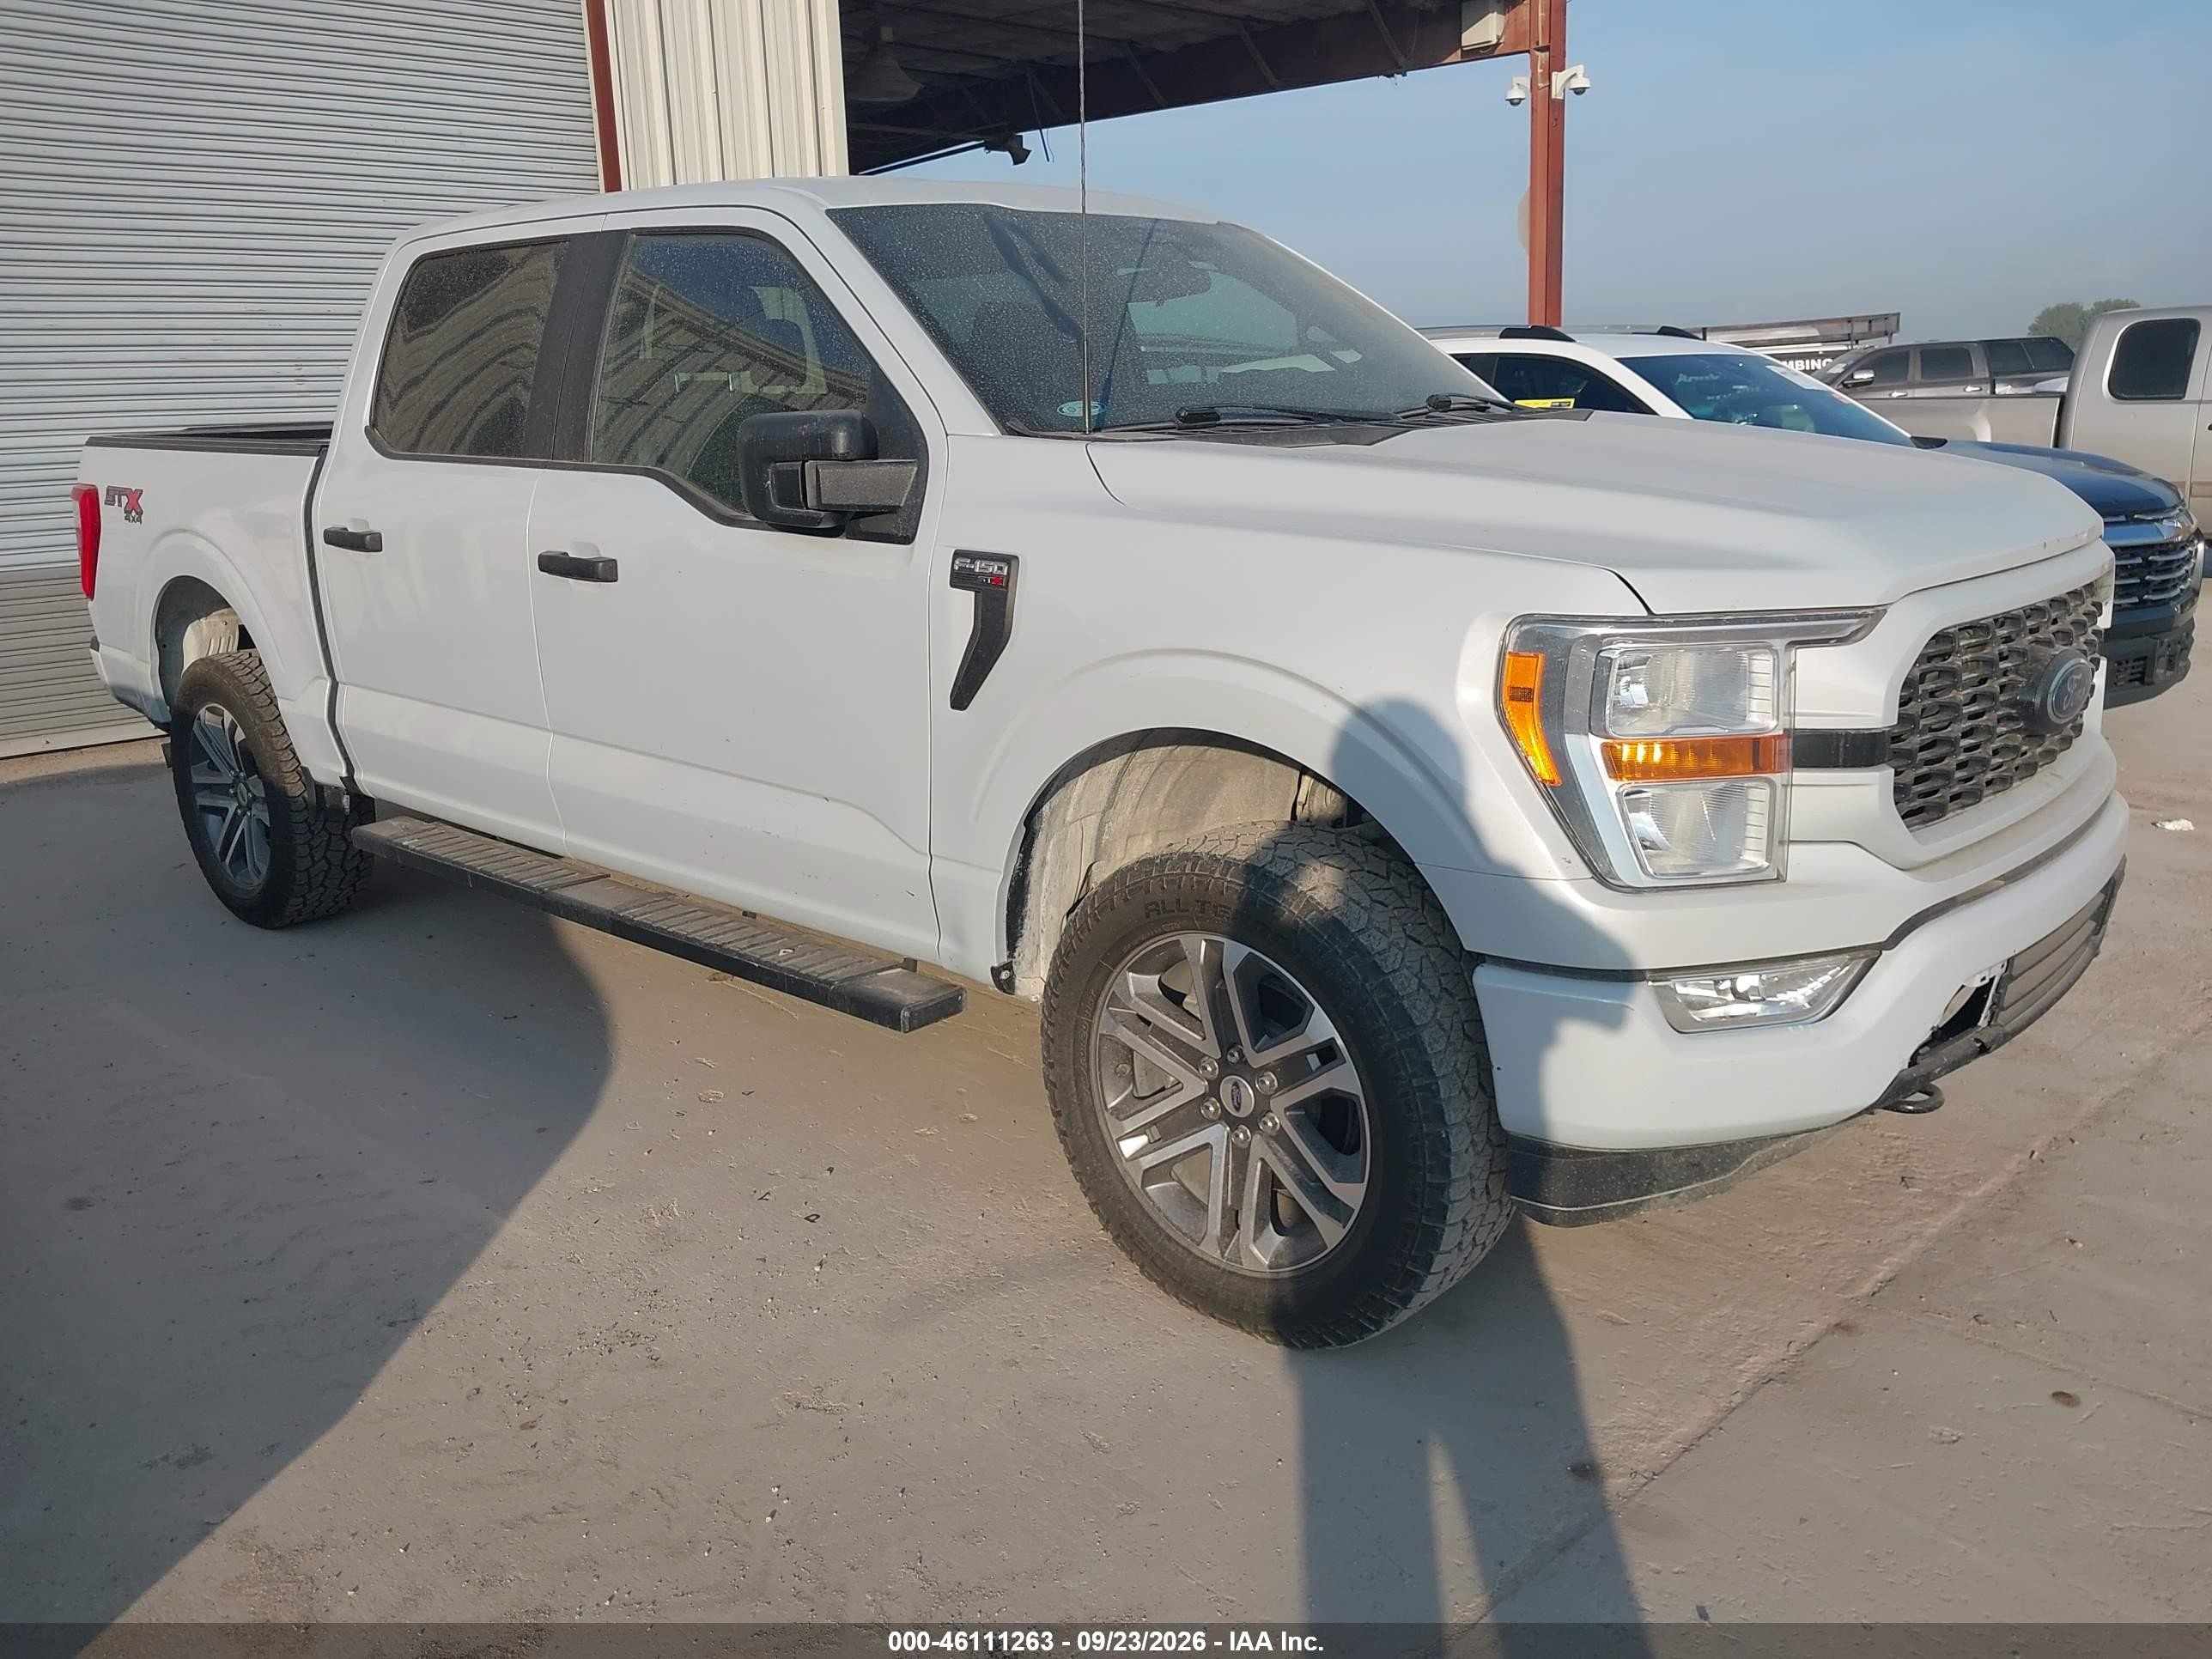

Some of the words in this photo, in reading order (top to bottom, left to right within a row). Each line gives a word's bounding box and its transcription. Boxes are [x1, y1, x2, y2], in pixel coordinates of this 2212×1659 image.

[104, 485, 144, 516] STX
[953, 556, 1009, 576] F-150
[1145, 898, 1190, 919] ALL
